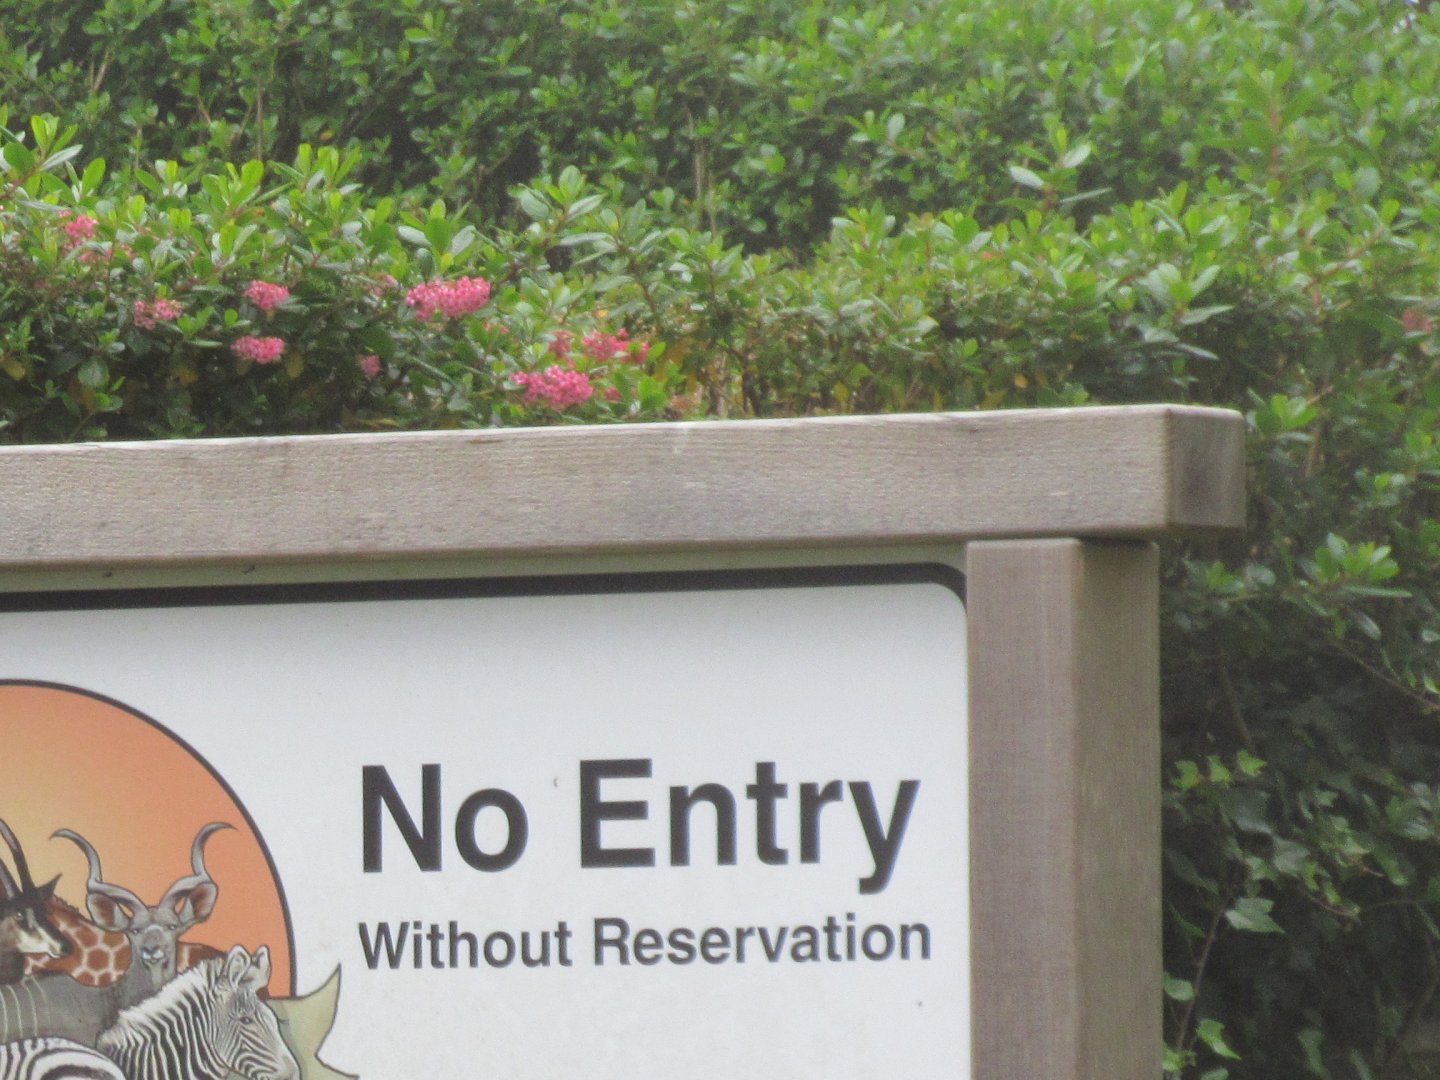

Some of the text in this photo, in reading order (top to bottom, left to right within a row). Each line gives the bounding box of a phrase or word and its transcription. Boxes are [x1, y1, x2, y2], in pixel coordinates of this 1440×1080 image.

[363, 758, 919, 895] No Entry
[358, 916, 931, 970] Without Reservation
